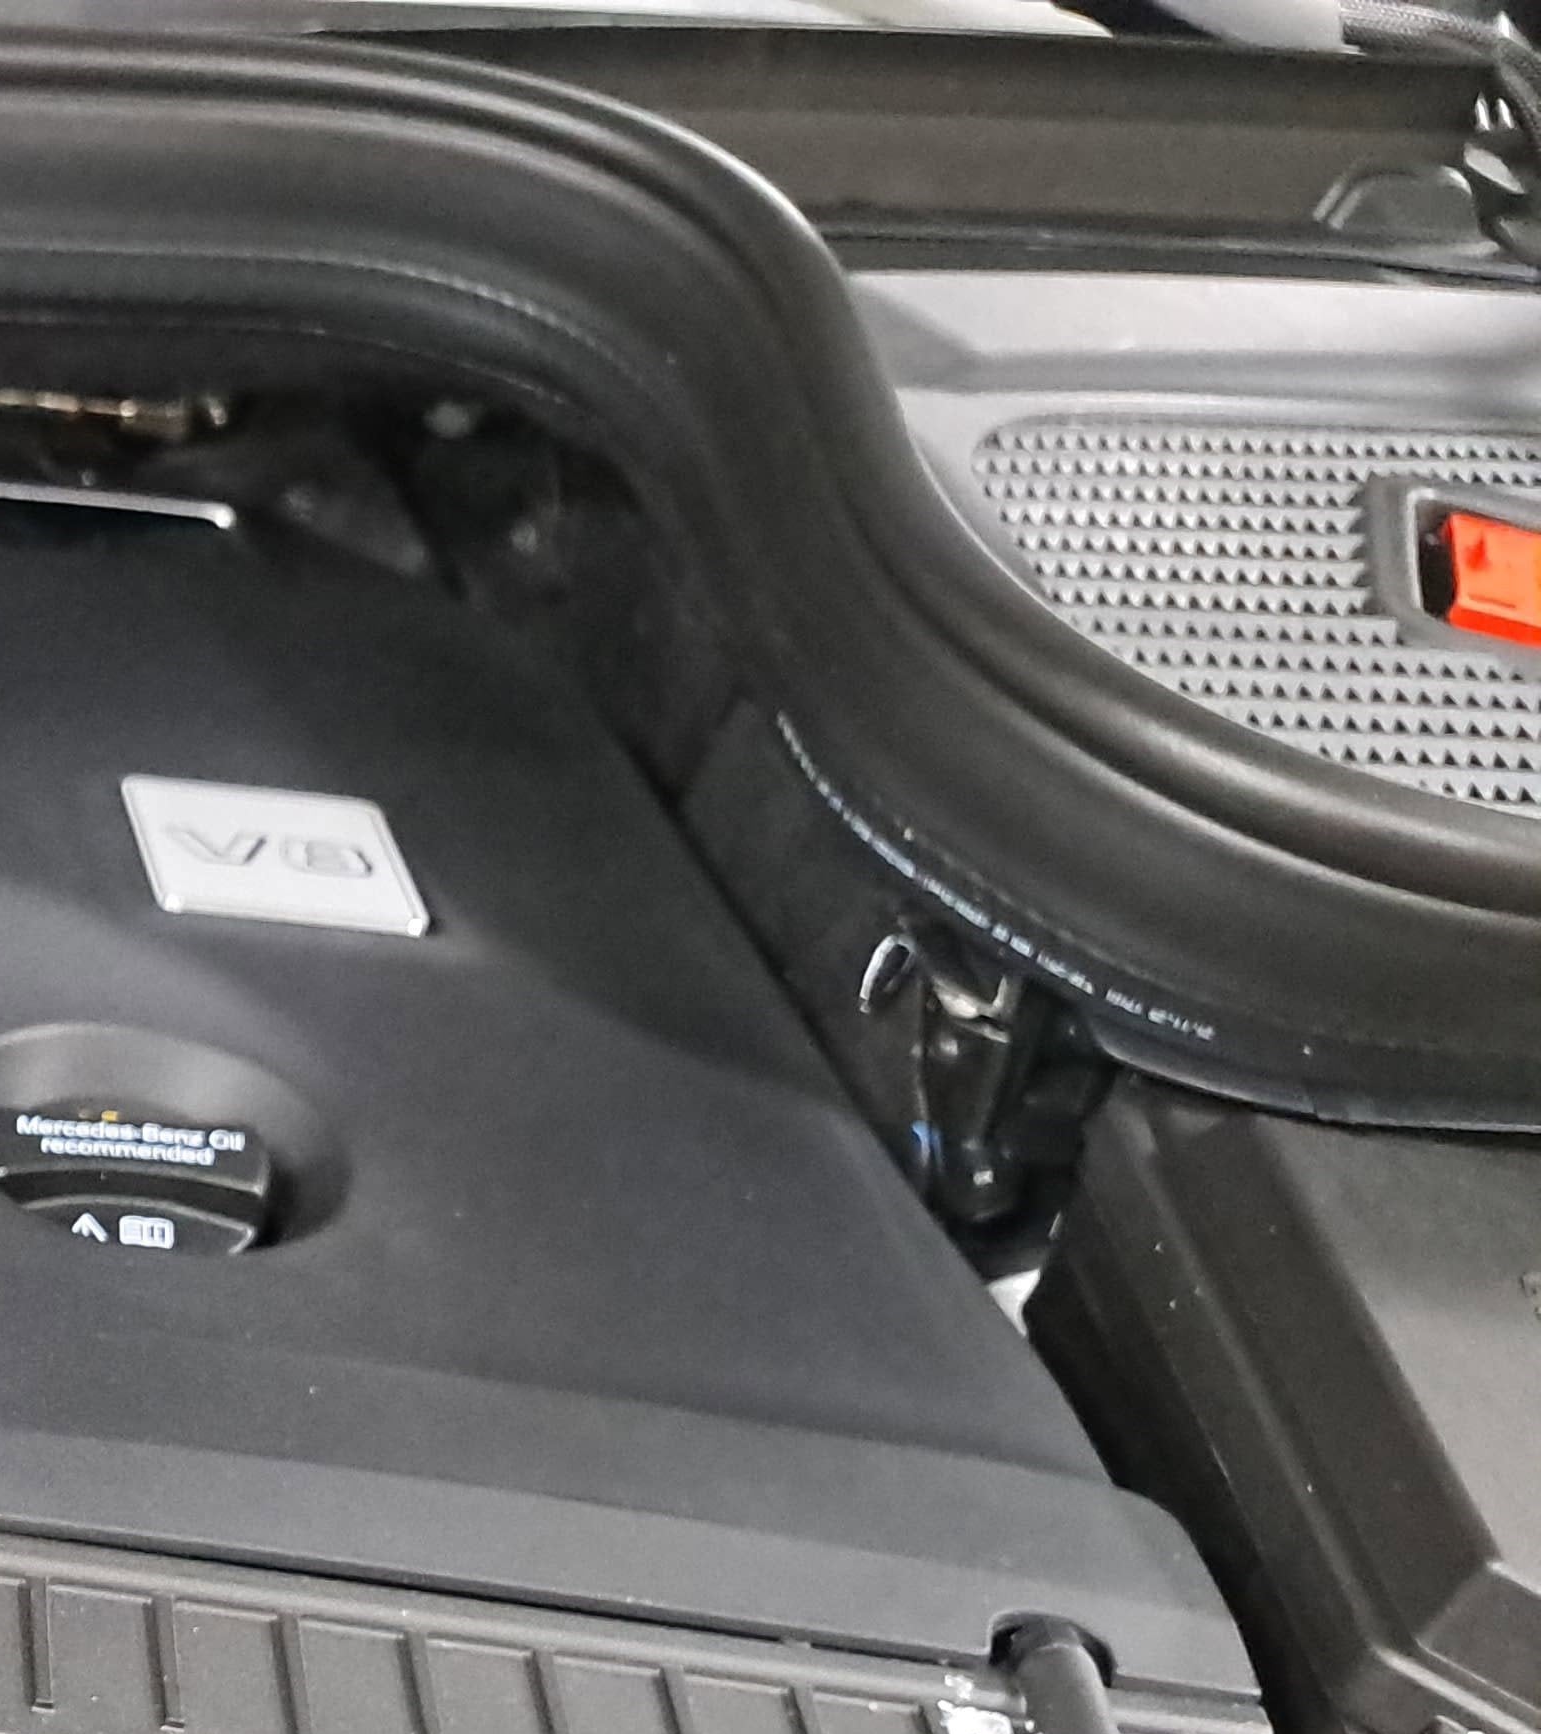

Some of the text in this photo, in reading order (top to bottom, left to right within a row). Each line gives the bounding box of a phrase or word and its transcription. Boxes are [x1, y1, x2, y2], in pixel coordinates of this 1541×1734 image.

[16, 1114, 246, 1152] Mercedes-Benz Oil
[40, 1136, 215, 1166] recommended
